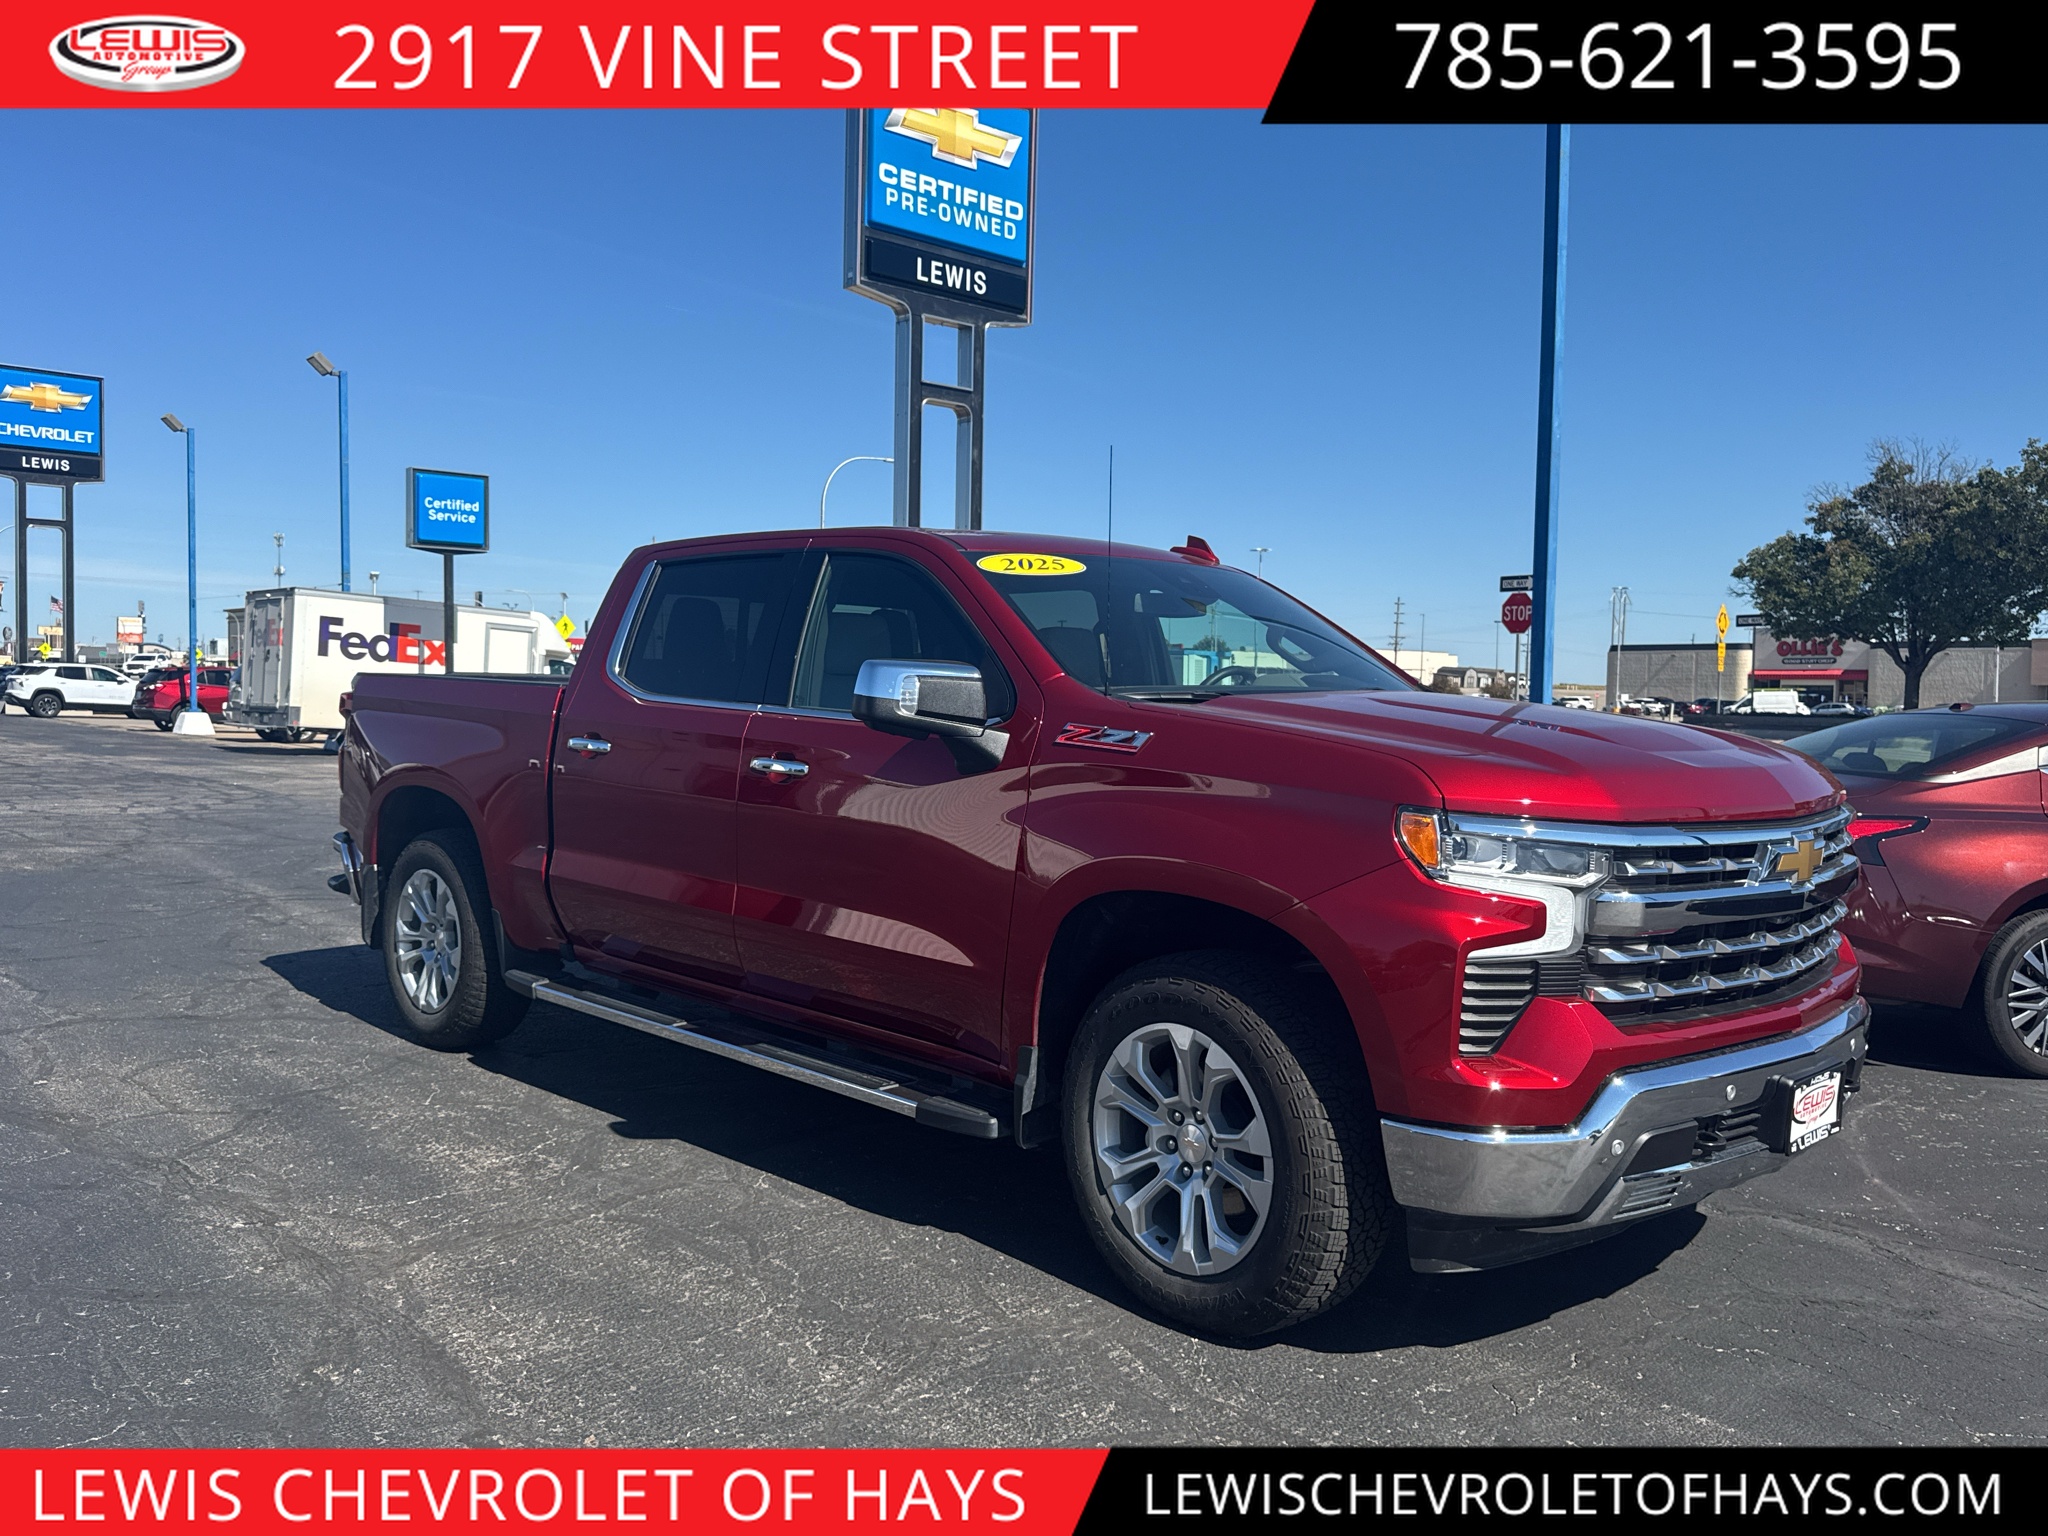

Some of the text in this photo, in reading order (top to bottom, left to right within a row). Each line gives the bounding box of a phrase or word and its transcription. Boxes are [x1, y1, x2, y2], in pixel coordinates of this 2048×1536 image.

[878, 162, 1024, 221] CERTIFIED
[886, 187, 1016, 241] PRE-OWNED
[916, 256, 987, 295] LEWIS
[0, 421, 95, 444] CHEVROLET
[22, 456, 70, 471] LEWIS
[424, 496, 480, 512] Certified
[428, 509, 476, 523] Service
[1000, 557, 1065, 571] 2025
[1503, 580, 1514, 588] ONE
[1503, 605, 1532, 623] STOP
[317, 615, 446, 667] FedEx
[1054, 722, 1154, 753] Z71
[1794, 1085, 1835, 1115] LEWIS
